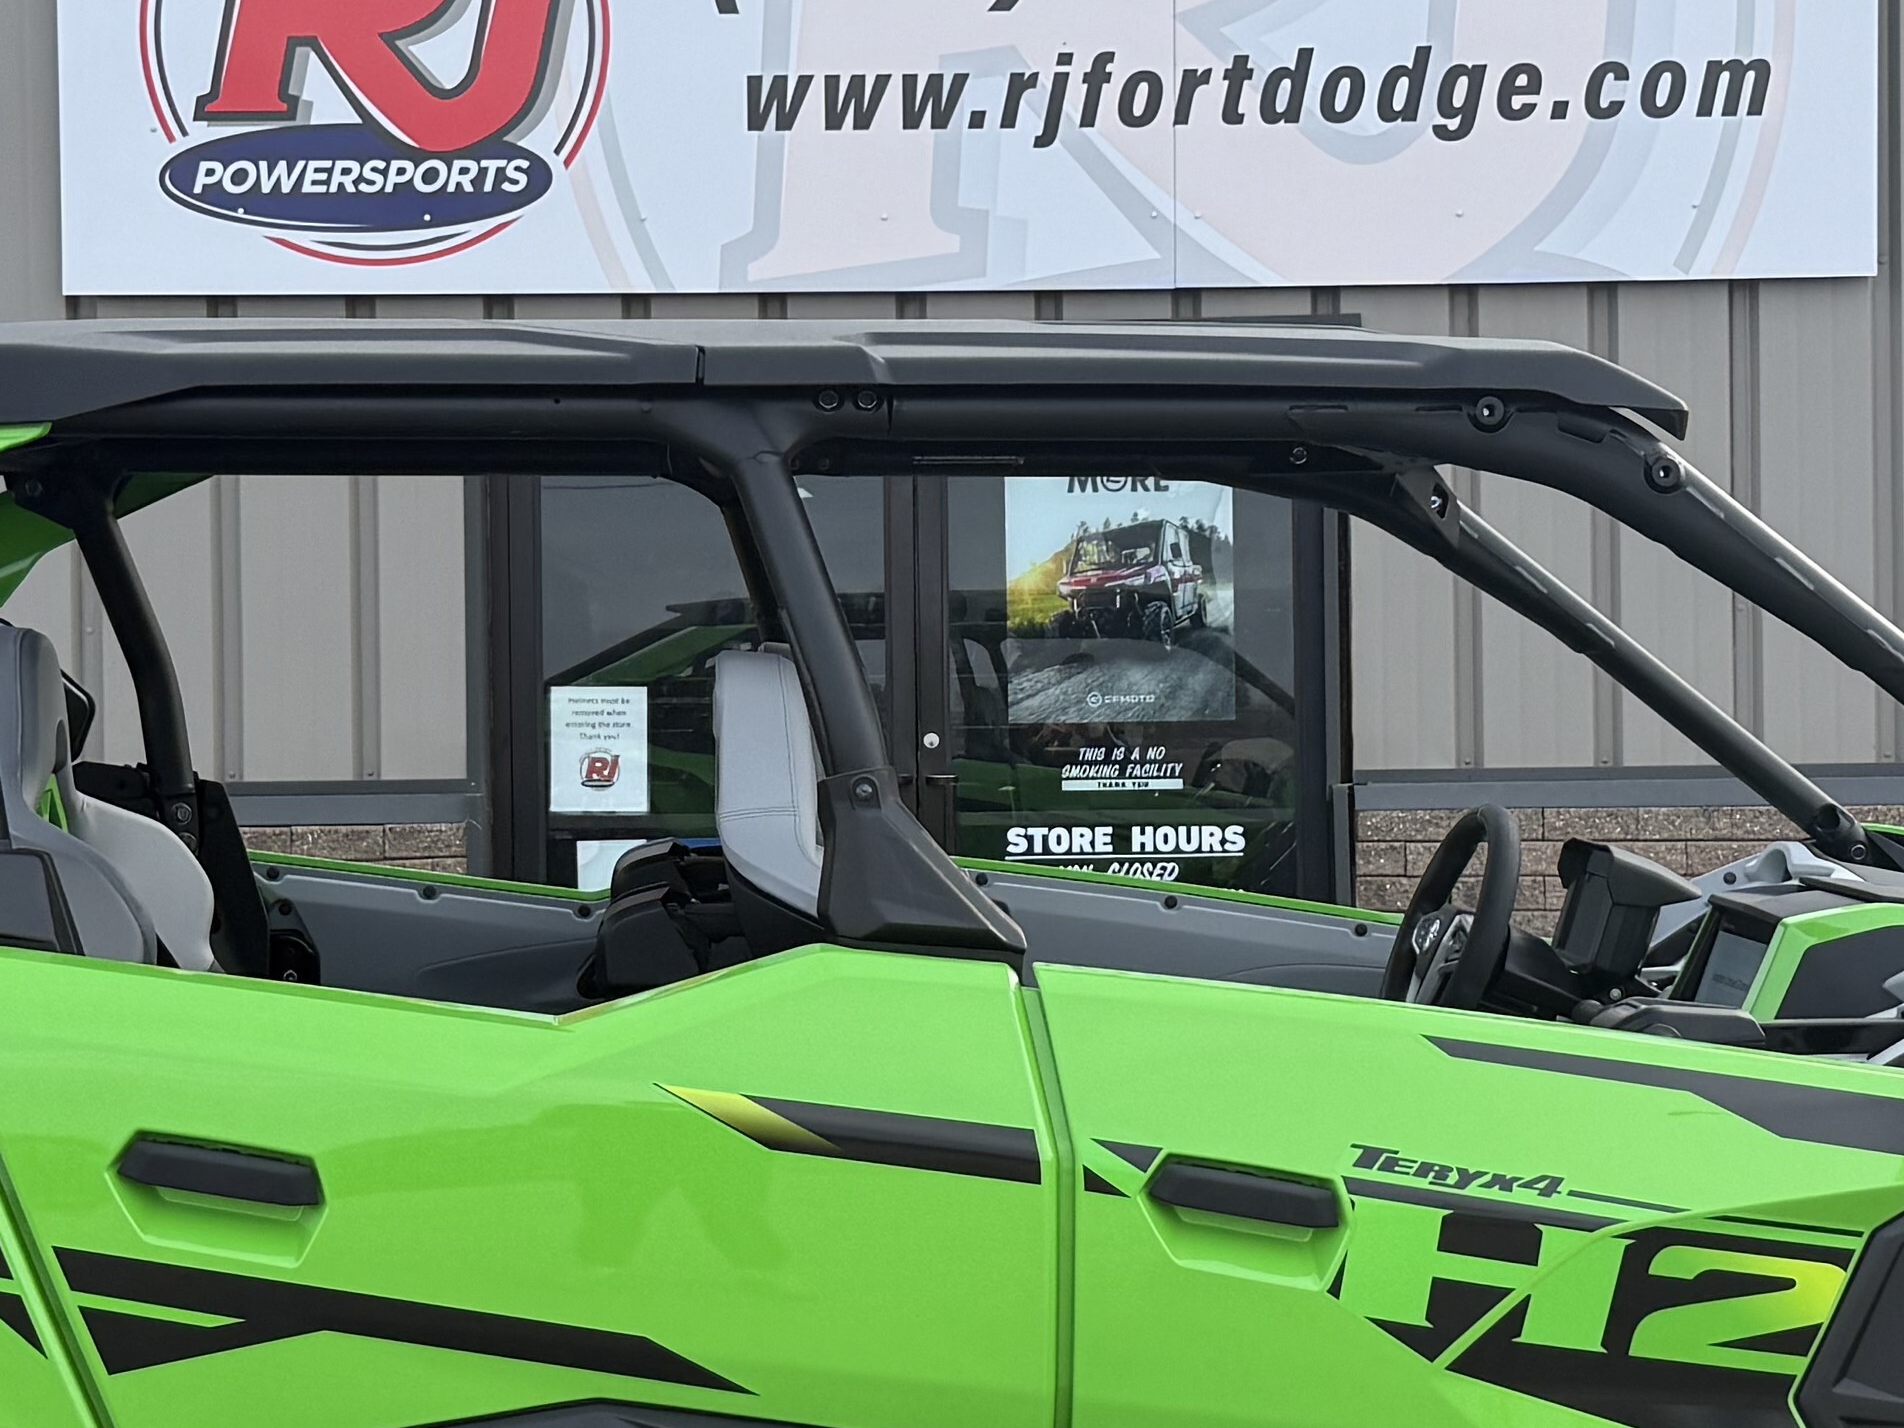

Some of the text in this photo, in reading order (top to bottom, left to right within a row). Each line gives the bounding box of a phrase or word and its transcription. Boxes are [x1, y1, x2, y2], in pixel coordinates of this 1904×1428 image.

[745, 45, 1772, 151] www.rjfortdodge.com
[192, 158, 531, 195] POWERSPORTS
[1104, 694, 1155, 703] CFMOTO
[1078, 746, 1166, 761] THIS IS A NO
[1061, 762, 1183, 779] SMOKING FACILITY
[1006, 825, 1246, 854] STORE HOURS
[1107, 862, 1179, 881] CLOSED
[1337, 1198, 1848, 1376] H2
